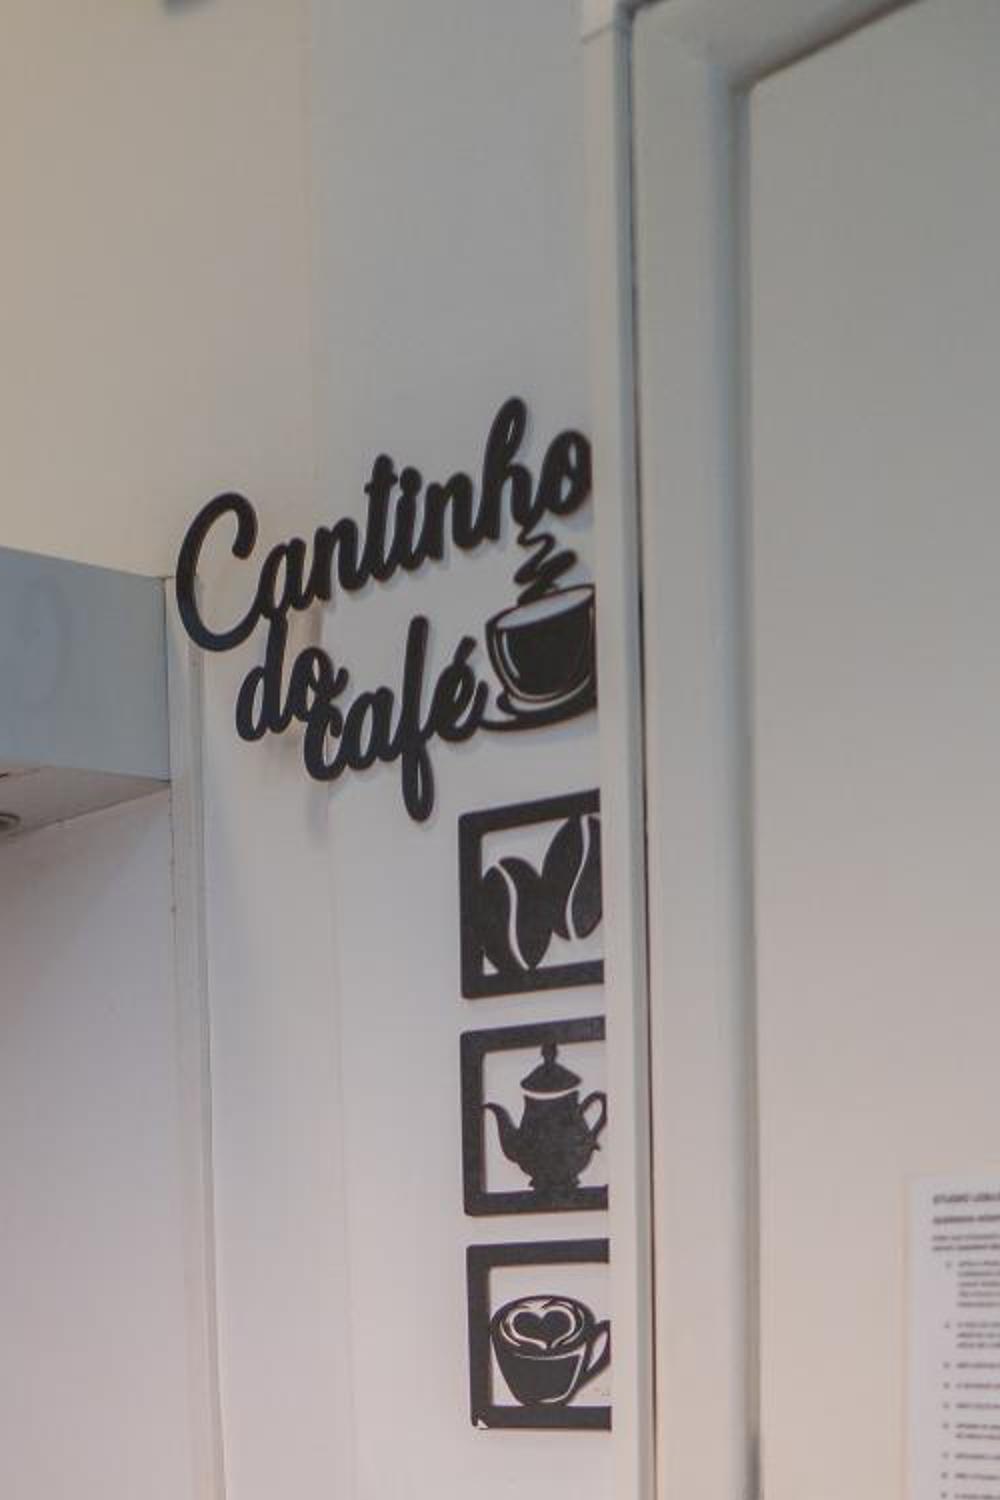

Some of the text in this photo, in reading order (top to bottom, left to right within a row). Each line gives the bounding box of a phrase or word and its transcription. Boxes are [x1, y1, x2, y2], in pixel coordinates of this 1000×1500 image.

[176, 397, 592, 652] Cantinho
[236, 609, 489, 822] do café
